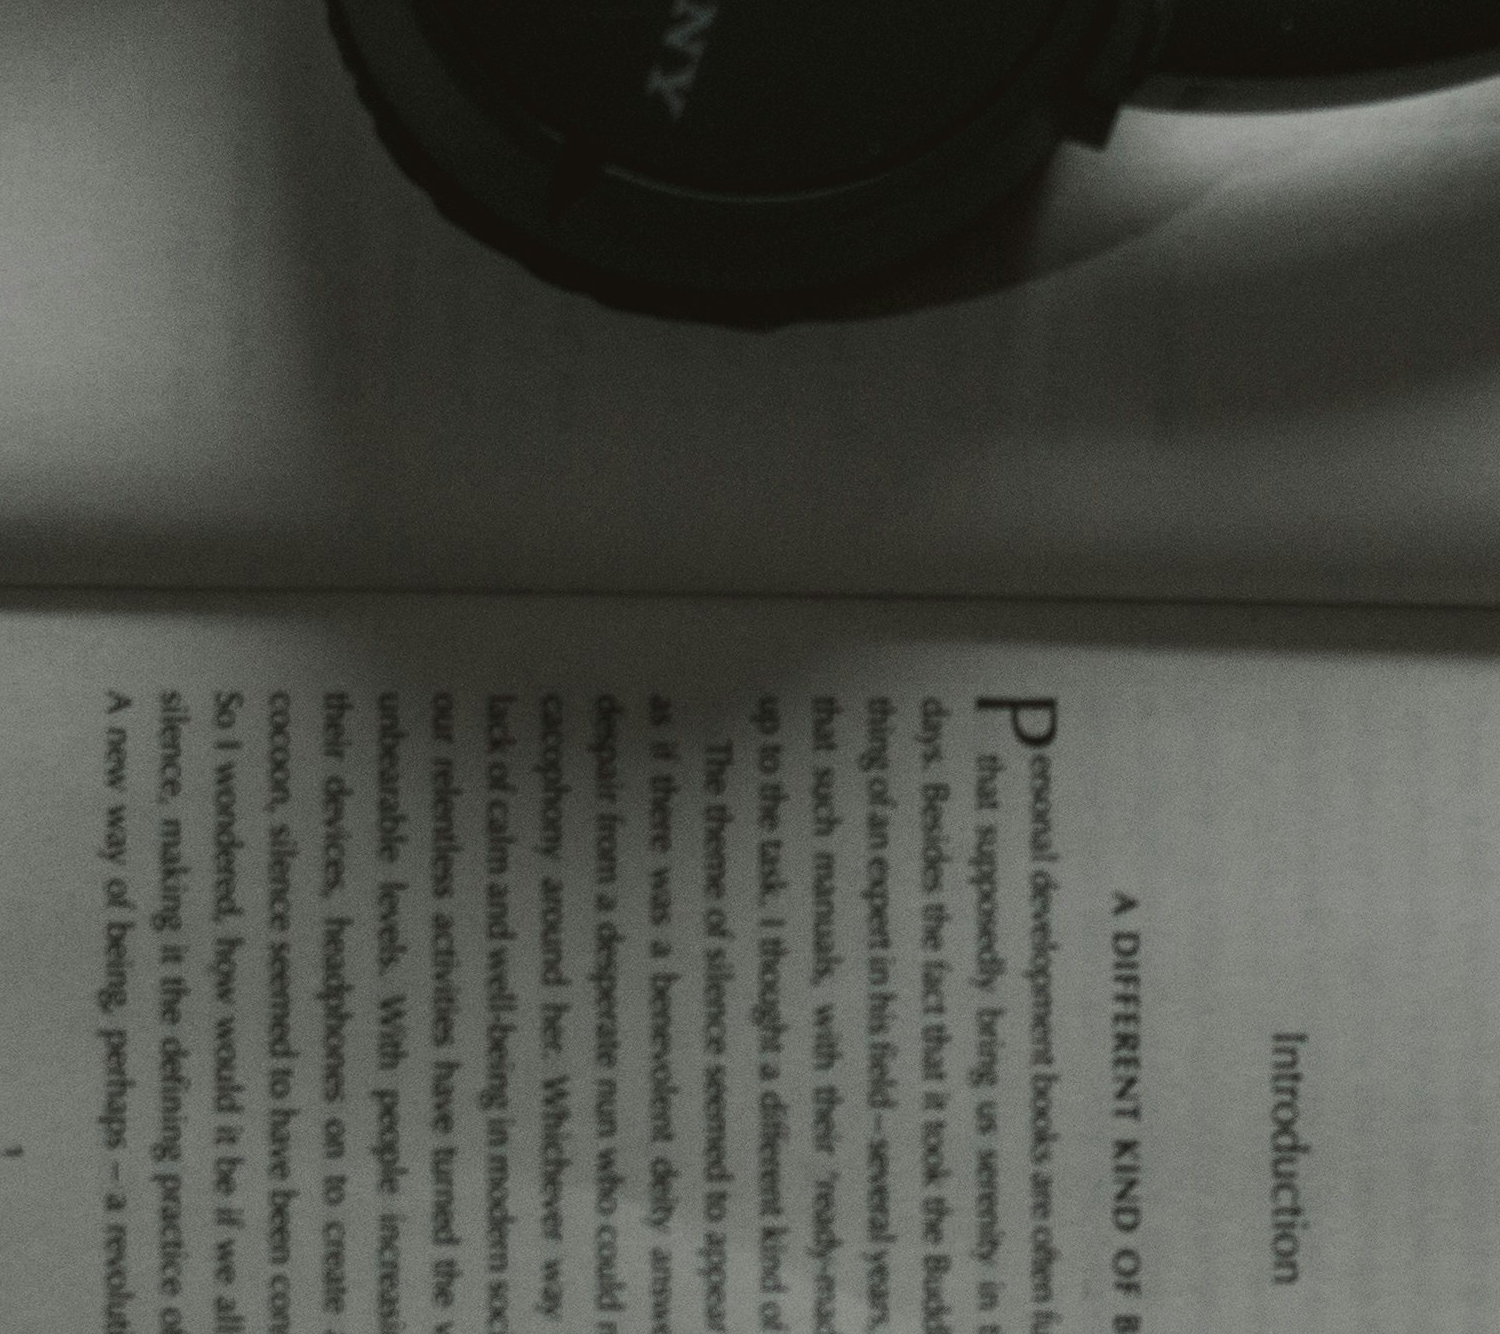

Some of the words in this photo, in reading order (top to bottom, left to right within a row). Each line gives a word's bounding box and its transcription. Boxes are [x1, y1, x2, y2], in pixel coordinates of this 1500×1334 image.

[156, 688, 191, 807] silence,
[212, 692, 245, 730] So
[264, 689, 292, 813] cocoon,
[321, 690, 355, 761] their
[430, 691, 456, 744] our
[481, 693, 518, 756] lack
[585, 693, 627, 805] despair
[748, 692, 781, 737] up
[809, 695, 845, 753] that
[856, 695, 898, 773] thing
[913, 695, 952, 772] days.
[104, 726, 128, 792] new
[374, 690, 410, 864] unbearable
[531, 693, 574, 860] cacophony
[701, 738, 736, 797] The
[974, 753, 1006, 811] that
[97, 803, 127, 865] way
[211, 762, 245, 922] wondered,
[319, 774, 354, 898] devices,
[429, 756, 464, 900] relentless
[483, 797, 518, 877] calm
[647, 772, 682, 855] there
[756, 782, 790, 832] the
[809, 767, 844, 837] such
[865, 810, 890, 852] an
[920, 781, 952, 895] Besides
[149, 816, 191, 936] making
[267, 823, 299, 933] silence
[593, 811, 627, 886] from
[700, 803, 735, 901] theme
[757, 839, 789, 905] task.
[376, 881, 409, 976] levels.
[485, 881, 518, 942] and
[539, 876, 572, 987] around
[647, 865, 673, 928] was
[809, 851, 844, 985] manuals,
[860, 854, 892, 951] expert
[921, 902, 952, 952] the
[968, 824, 1006, 993] supposedly
[1111, 891, 1140, 918] A
[95, 920, 136, 1015] being,
[158, 974, 191, 1030] the
[213, 937, 245, 1003] how
[266, 941, 300, 1060] seemed
[430, 912, 461, 1048] activities
[586, 920, 626, 1070] desperate
[703, 947, 735, 1056] silence
[749, 937, 790, 1053] thought
[921, 959, 952, 1016] fact
[1022, 869, 1060, 1067] development
[314, 916, 354, 1104] headphones
[376, 994, 409, 1071] With
[476, 945, 518, 1112] well-being
[540, 1003, 571, 1061] her.
[812, 1004, 843, 1071] with
[867, 991, 897, 1036] his
[967, 1007, 1006, 1089] bring
[1111, 930, 1142, 1123] DIFFERENT
[95, 1027, 136, 1151] perhaps
[213, 1017, 245, 1113] would
[648, 971, 681, 1143] benevolent
[866, 1041, 898, 1110] field
[921, 1023, 952, 1082] that
[150, 1033, 191, 1165] defining
[429, 1060, 462, 1135] have
[594, 1077, 618, 1139] nun
[703, 1064, 735, 1184] seemed
[812, 1085, 844, 1154] their
[1029, 1072, 1060, 1166] books
[2, 1144, 24, 1159] 1
[213, 1157, 245, 1195] be
[267, 1107, 300, 1182] have
[322, 1117, 346, 1160] on
[369, 1088, 409, 1196] people
[539, 1075, 573, 1241] Whichever
[757, 1090, 789, 1217] different
[921, 1119, 952, 1187] took
[1270, 1031, 1312, 1286] Introduction
[430, 1146, 462, 1246] turned
[485, 1152, 517, 1274] modern
[593, 1147, 628, 1217] who
[644, 1155, 680, 1232] deity
[866, 1137, 898, 1245] several
[921, 1195, 953, 1246] the
[970, 1148, 1004, 1266] serenity
[1029, 1171, 1053, 1221] are
[1111, 1137, 1142, 1235] KIND
[150, 1170, 188, 1299] practice
[214, 1240, 236, 1284] we
[267, 1188, 300, 1266] been
[321, 1220, 348, 1314] create
[757, 1226, 790, 1293] kind
[1030, 1225, 1060, 1304] often
[432, 1259, 463, 1308] the
[534, 1259, 563, 1316] way
[594, 1223, 626, 1312] could
[697, 1231, 728, 1333] appear
[861, 1249, 890, 1334] years,
[1111, 1246, 1143, 1298] OF
